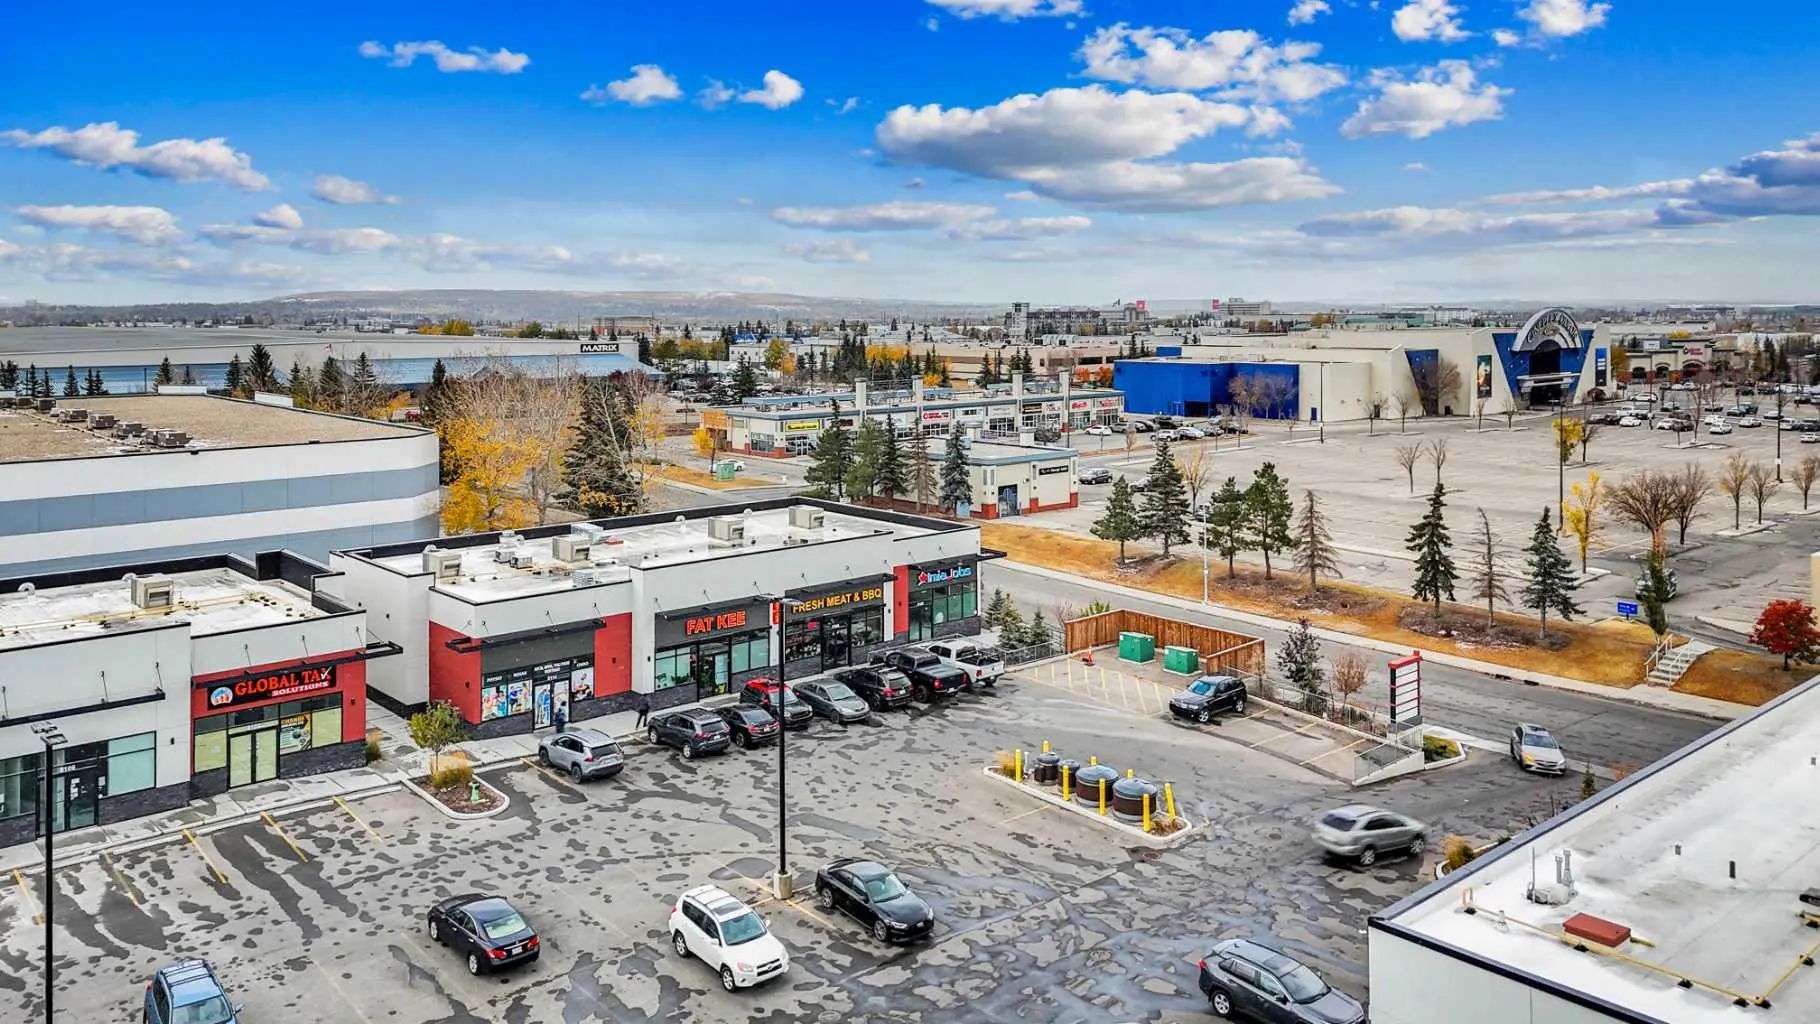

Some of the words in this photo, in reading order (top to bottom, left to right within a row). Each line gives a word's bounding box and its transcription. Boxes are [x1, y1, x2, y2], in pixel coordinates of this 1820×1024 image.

[582, 344, 617, 352] MATRIX
[792, 599, 825, 614] FRESH
[826, 593, 852, 608] MEAT
[853, 591, 861, 602] &
[862, 588, 882, 601] BBQ
[685, 616, 714, 635] FAT
[716, 610, 746, 630] KEE
[234, 673, 300, 696] GLOBAL
[271, 680, 330, 697] SOLUTIONS
